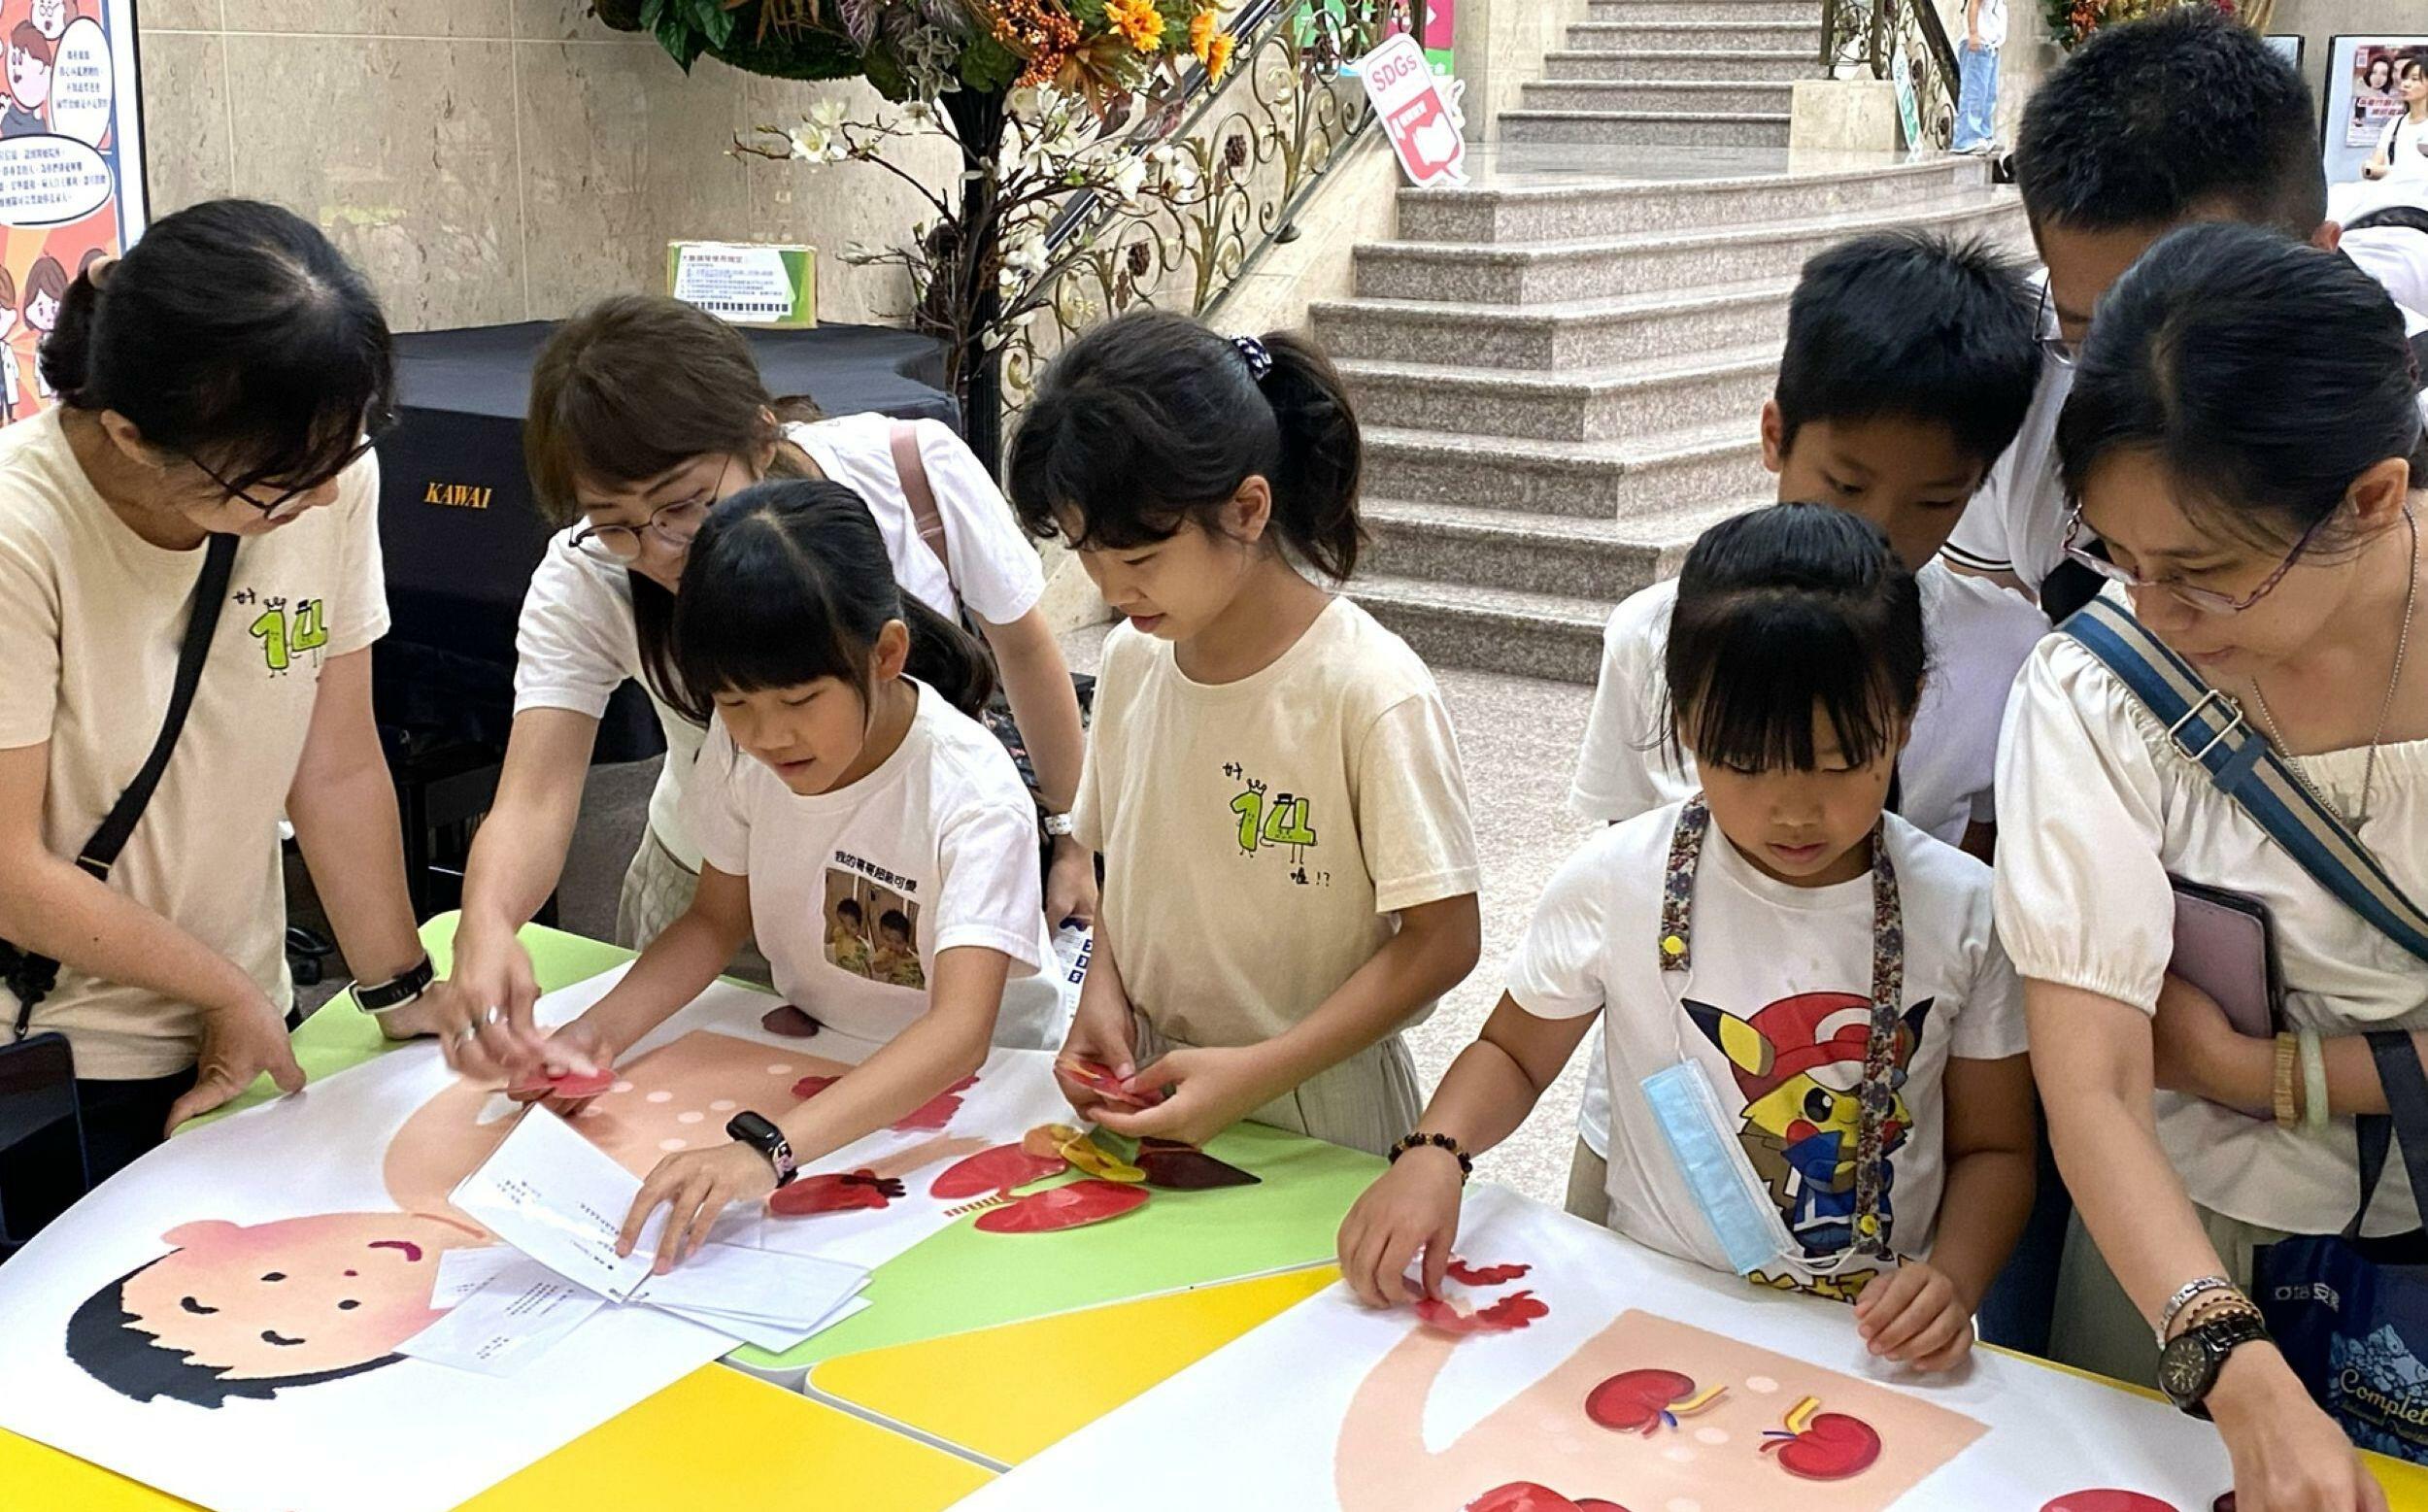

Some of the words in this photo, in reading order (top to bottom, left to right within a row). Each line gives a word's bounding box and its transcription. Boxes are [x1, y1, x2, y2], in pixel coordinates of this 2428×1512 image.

[1371, 55, 1418, 93] SDGs
[423, 481, 492, 510] KAWAI
[249, 598, 328, 670] 14
[1229, 790, 1317, 853] 14
